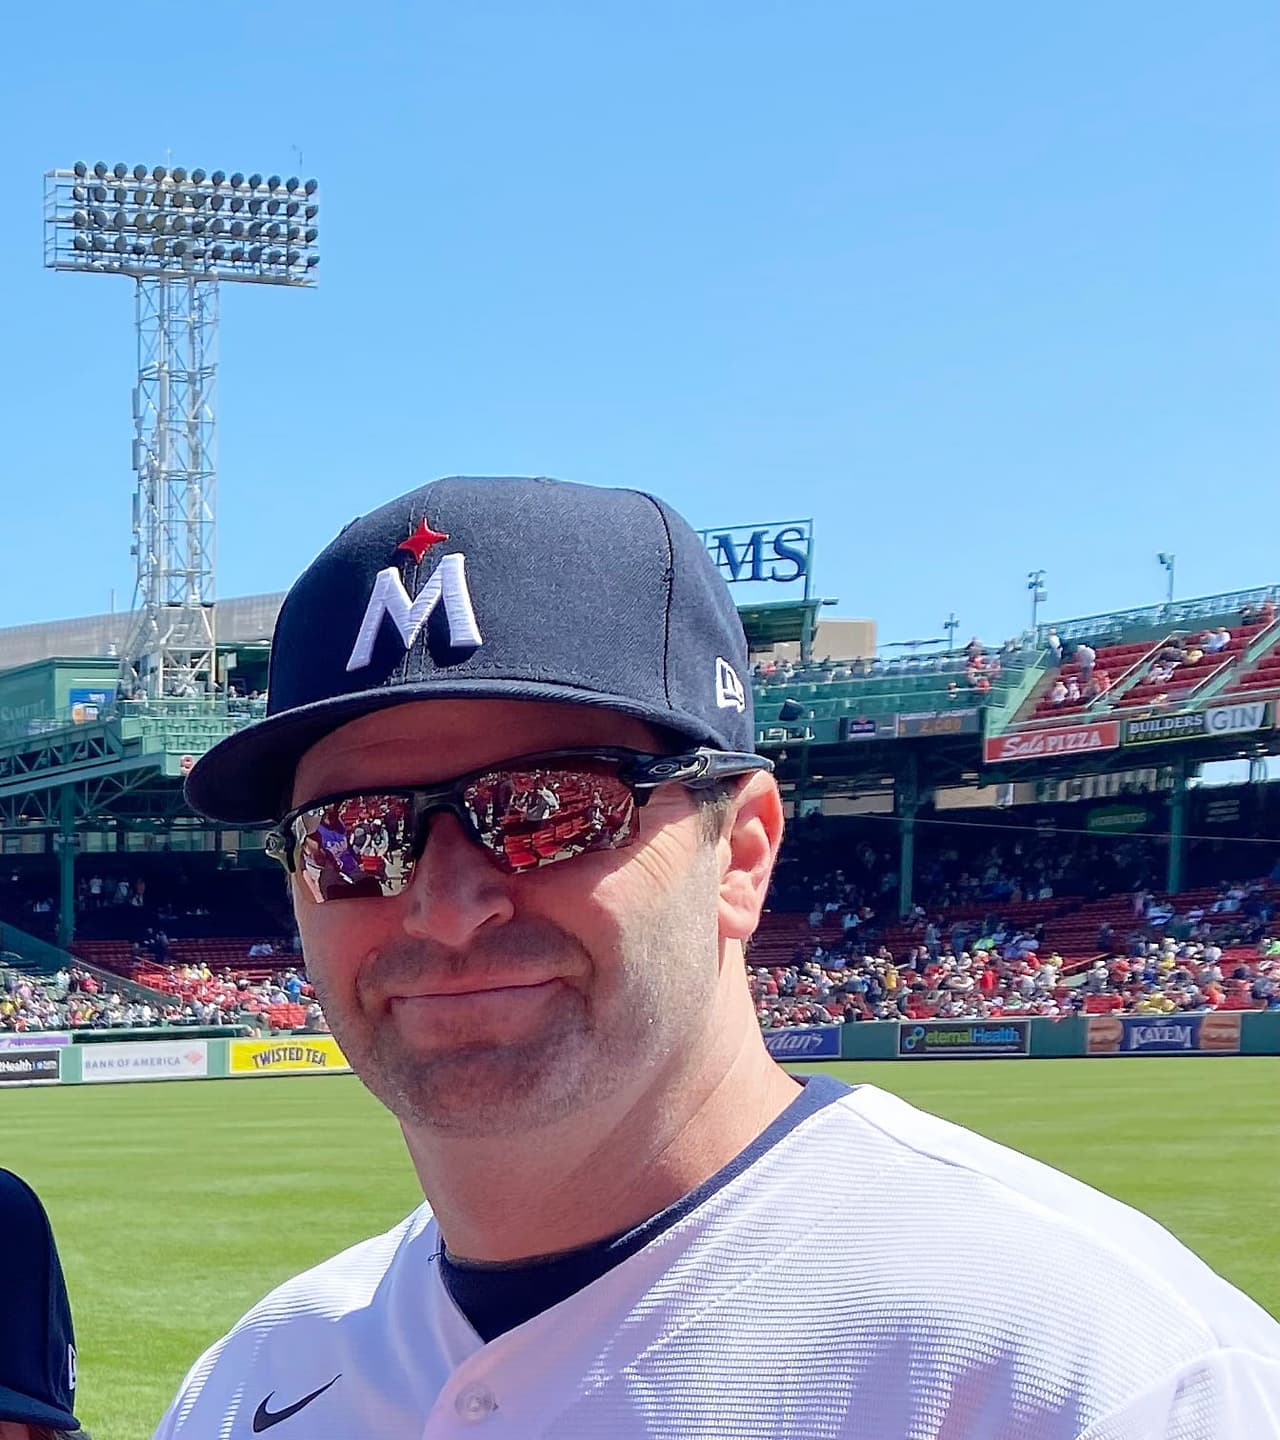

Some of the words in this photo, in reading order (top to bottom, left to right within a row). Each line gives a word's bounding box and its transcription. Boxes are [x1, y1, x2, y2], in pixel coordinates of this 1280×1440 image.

[713, 526, 808, 582] MS
[346, 552, 483, 672] M
[1130, 714, 1203, 734] BUILDERS
[1212, 706, 1258, 731] GIN
[1002, 734, 1045, 757] Sal's
[1048, 731, 1102, 752] PIZZA
[925, 1026, 1022, 1044] eternalHealth
[1129, 1024, 1193, 1049] KAYEM
[85, 1058, 114, 1069] BANK
[117, 1058, 132, 1068] OF
[133, 1056, 181, 1067] AMERICA
[252, 1047, 304, 1069] TWISTED
[306, 1047, 327, 1067] TEA
